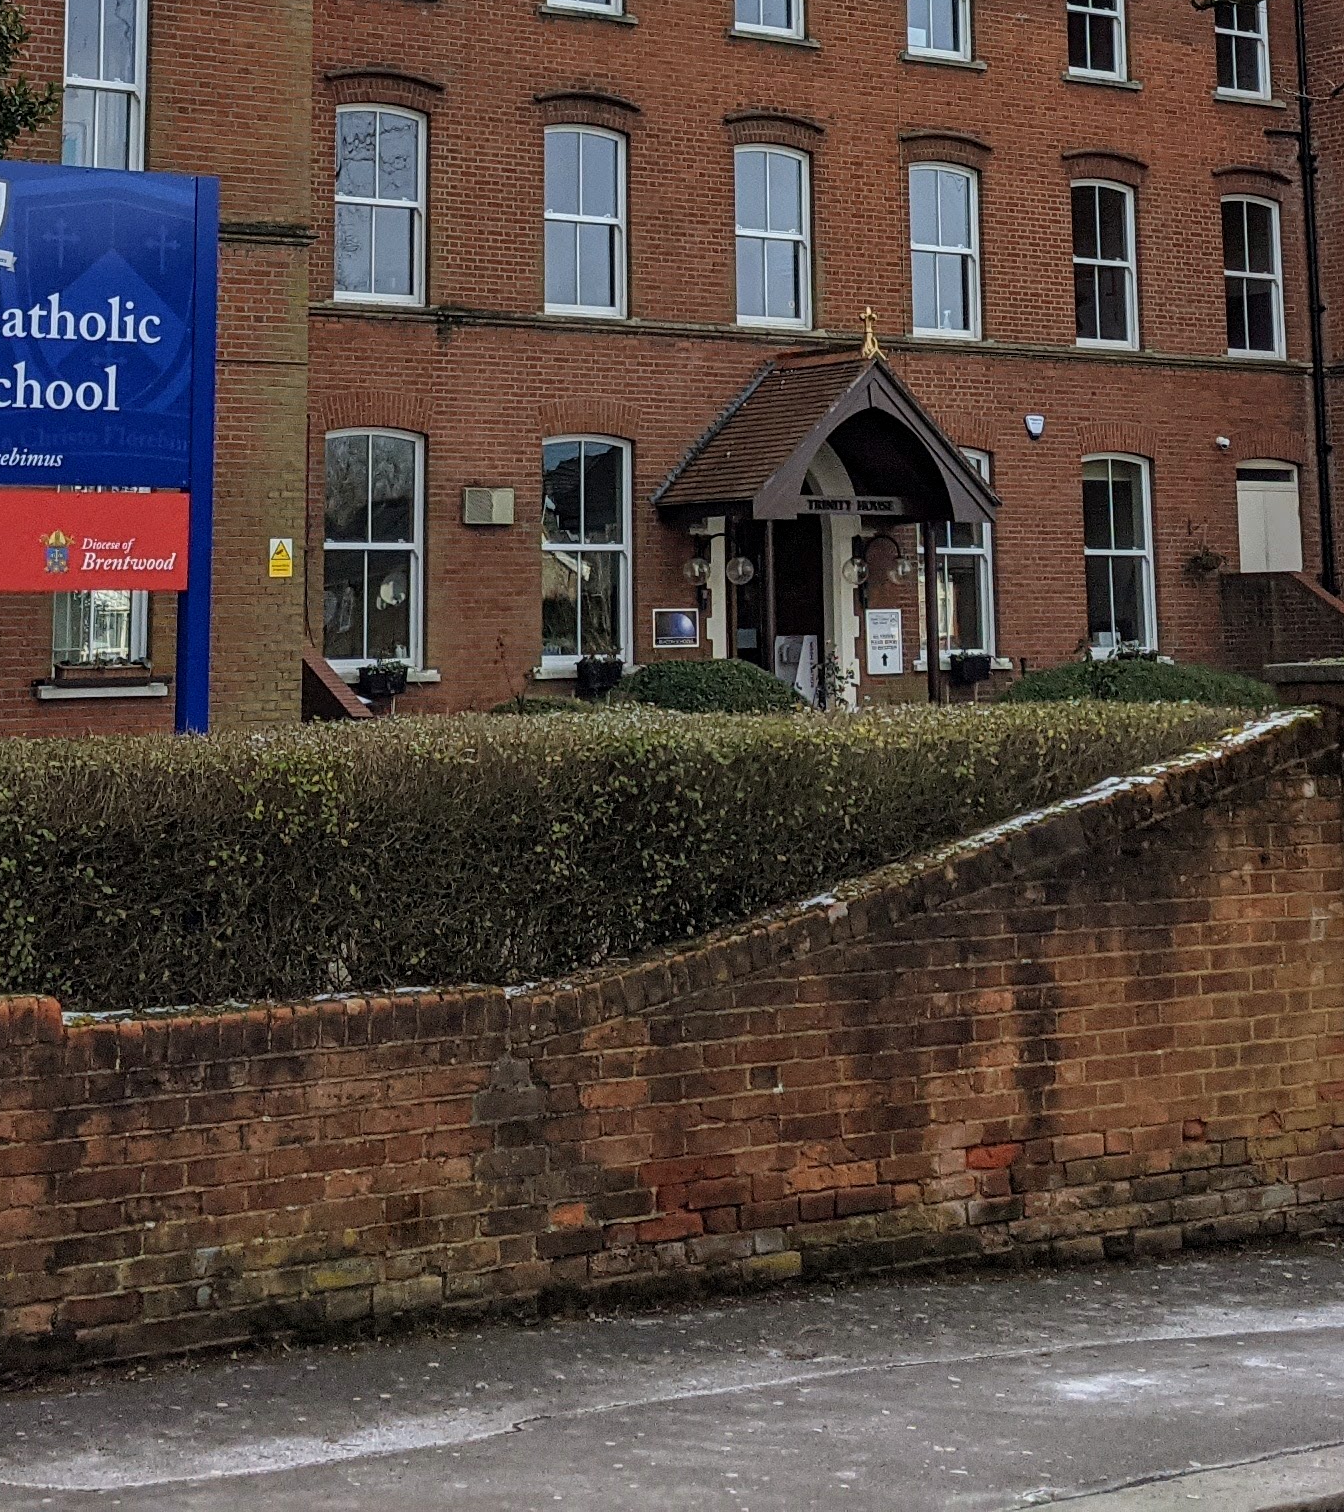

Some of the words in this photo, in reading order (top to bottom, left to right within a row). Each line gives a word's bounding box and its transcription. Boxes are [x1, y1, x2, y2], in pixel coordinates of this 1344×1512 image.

[807, 499, 852, 512] TRINITY
[856, 500, 894, 512] HOUSE
[82, 538, 121, 550] Diocese
[121, 538, 135, 553] of
[81, 552, 177, 571] Brentwood
